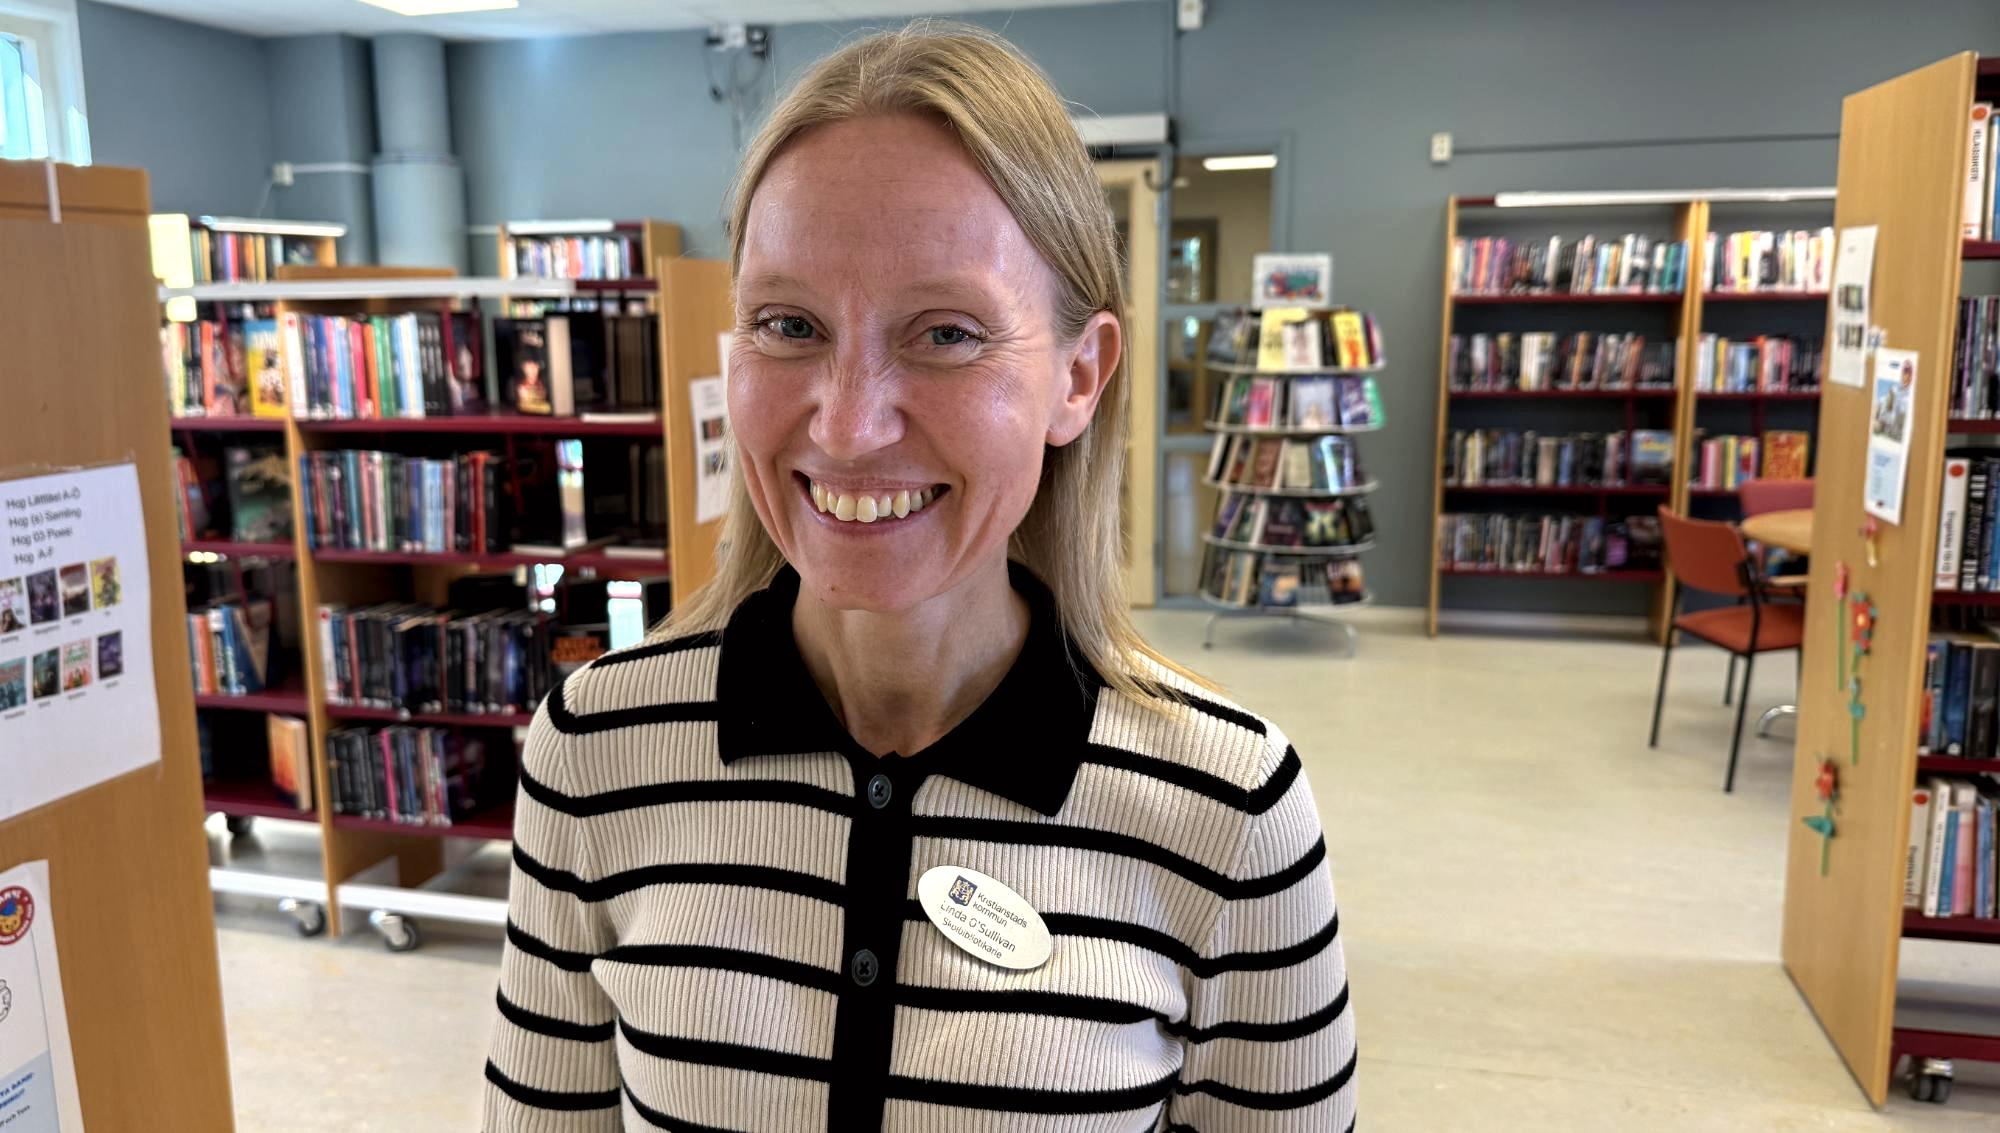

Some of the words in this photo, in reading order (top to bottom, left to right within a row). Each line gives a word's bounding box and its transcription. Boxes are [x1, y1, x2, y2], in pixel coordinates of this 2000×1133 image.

[940, 900, 967, 923] Linda
[968, 917, 1016, 952] O'Sullivan
[972, 901, 1008, 928] kommun
[977, 892, 1028, 928] Kristianstads
